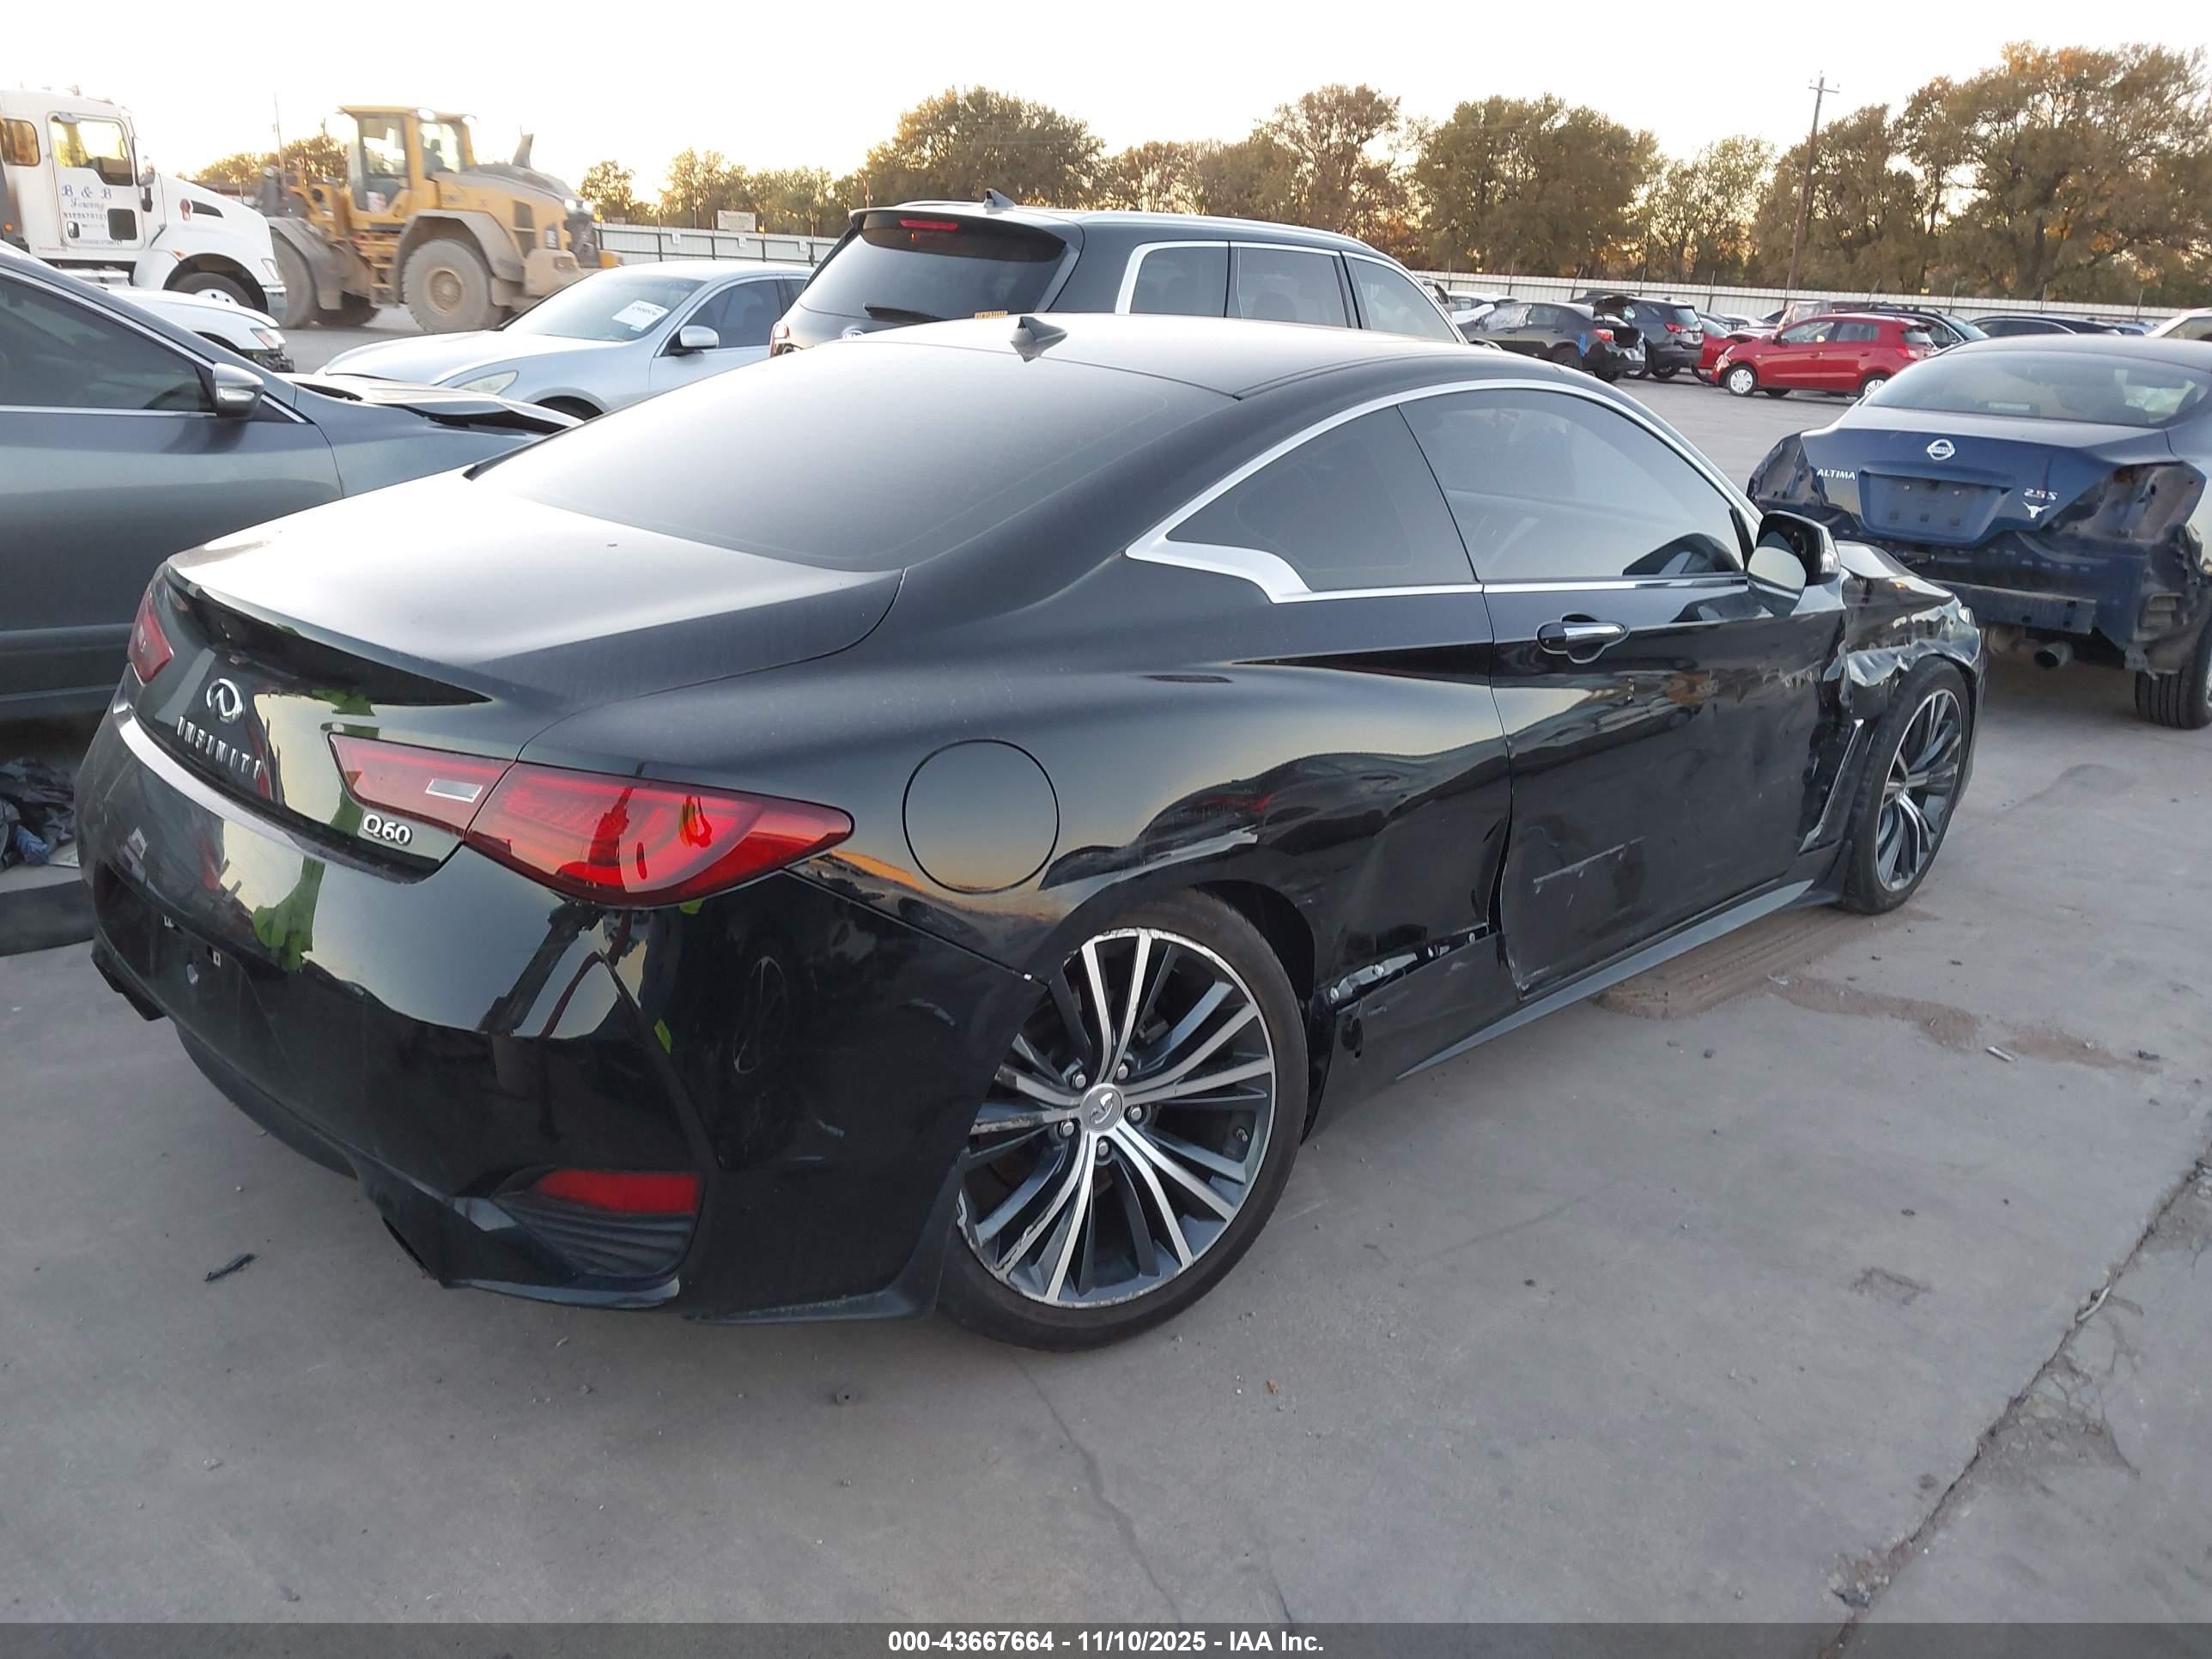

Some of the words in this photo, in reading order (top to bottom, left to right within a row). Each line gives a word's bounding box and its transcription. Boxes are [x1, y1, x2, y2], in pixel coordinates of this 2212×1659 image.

[62, 184, 74, 197] B
[82, 185, 93, 198] &
[100, 187, 112, 199] B
[1816, 467, 1856, 481] ALTIMA
[177, 715, 261, 780] INFINITI
[363, 814, 412, 845] Q60
